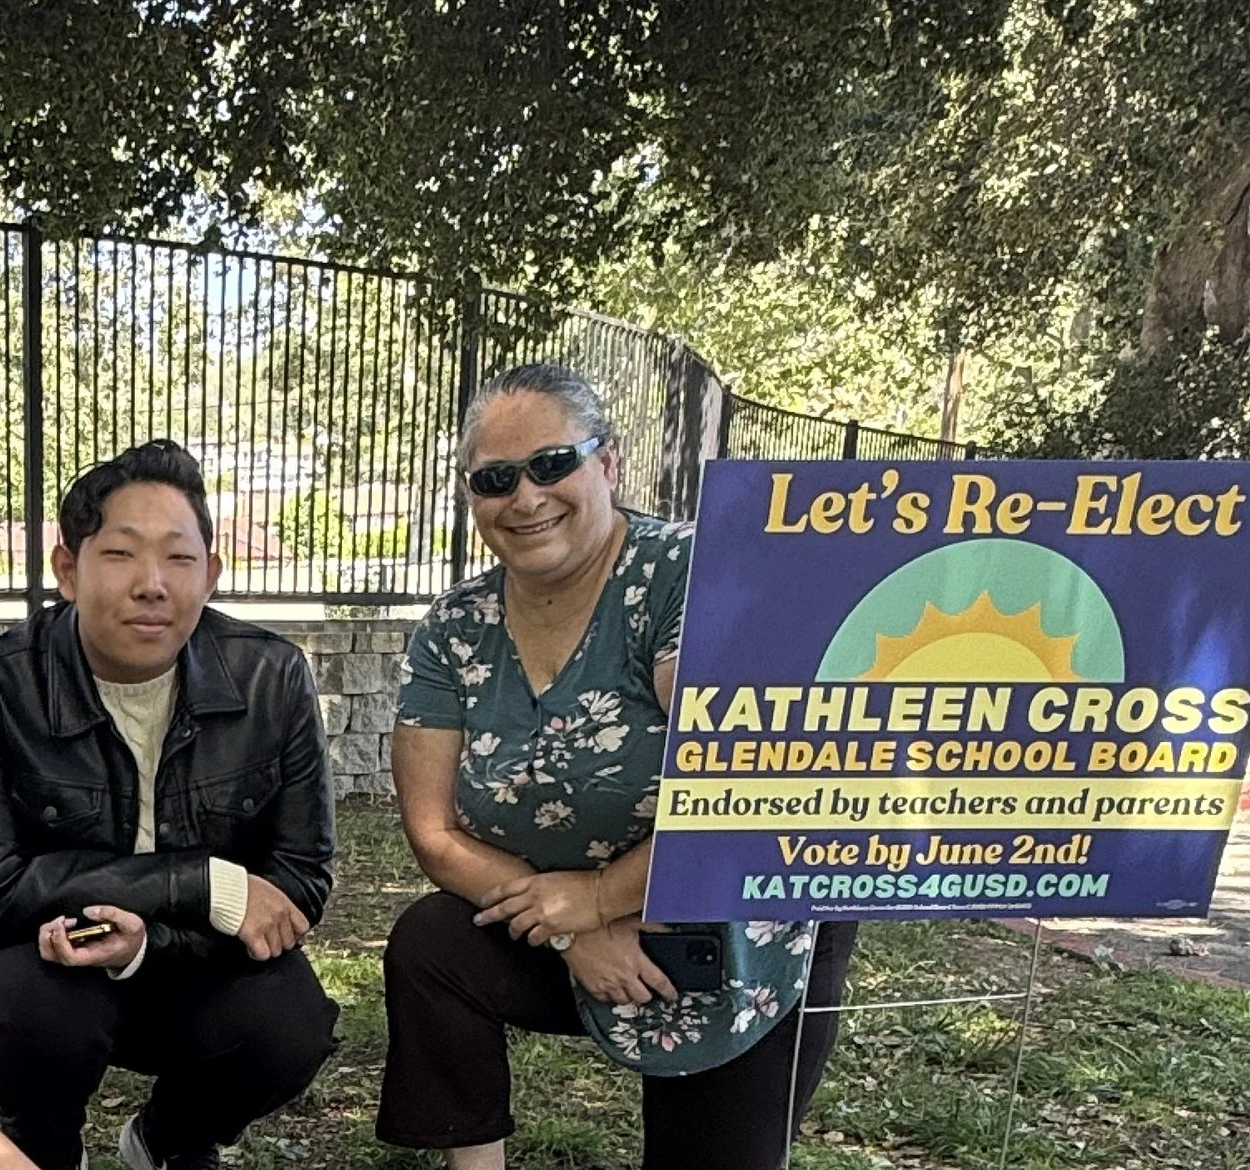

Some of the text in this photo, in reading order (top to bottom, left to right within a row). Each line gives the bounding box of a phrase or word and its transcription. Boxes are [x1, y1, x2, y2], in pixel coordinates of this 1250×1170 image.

[765, 470, 1247, 536] Let's Re-Elect
[678, 686, 1250, 735] KATHLEEN CROSS
[676, 741, 1238, 773] GLENDALE SCHOOL BOARD
[668, 788, 1225, 822] Endorsed by teachers and parents
[778, 834, 1092, 873] Vote by June 2nd!
[743, 874, 1110, 899] KATCROSS4GUSD.COM
